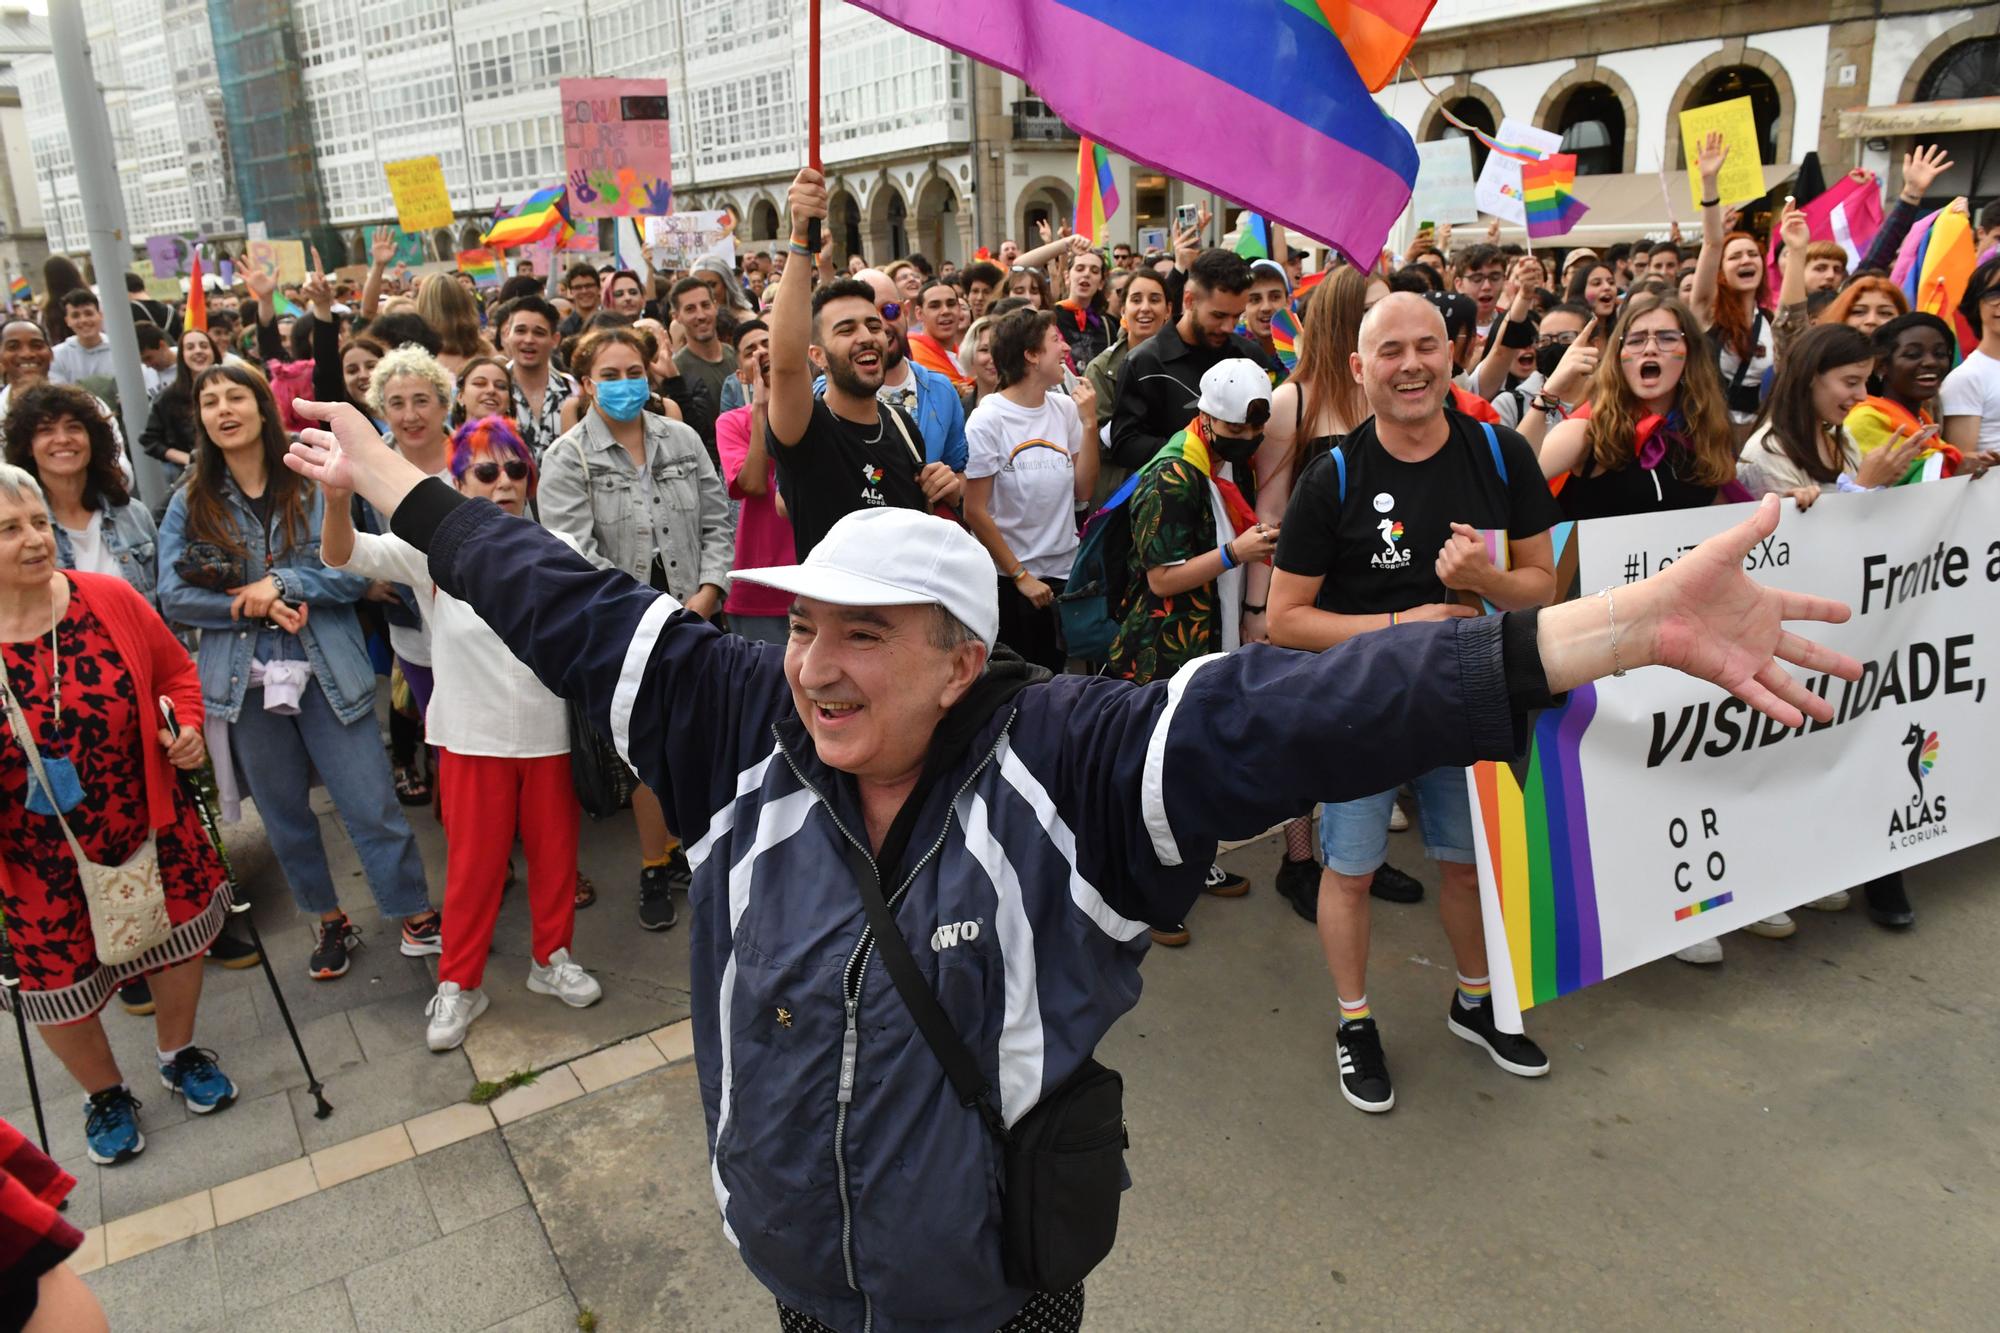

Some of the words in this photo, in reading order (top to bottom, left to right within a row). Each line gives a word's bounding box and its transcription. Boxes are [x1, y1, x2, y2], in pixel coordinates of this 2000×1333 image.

[637, 123, 670, 148] DE
[1370, 548, 1412, 565] ALAS
[1861, 541, 1969, 615] Fronte
[1888, 795, 1946, 837] ALAS
[1890, 841, 1897, 851] A
[1901, 824, 1948, 848] CORUÑA
